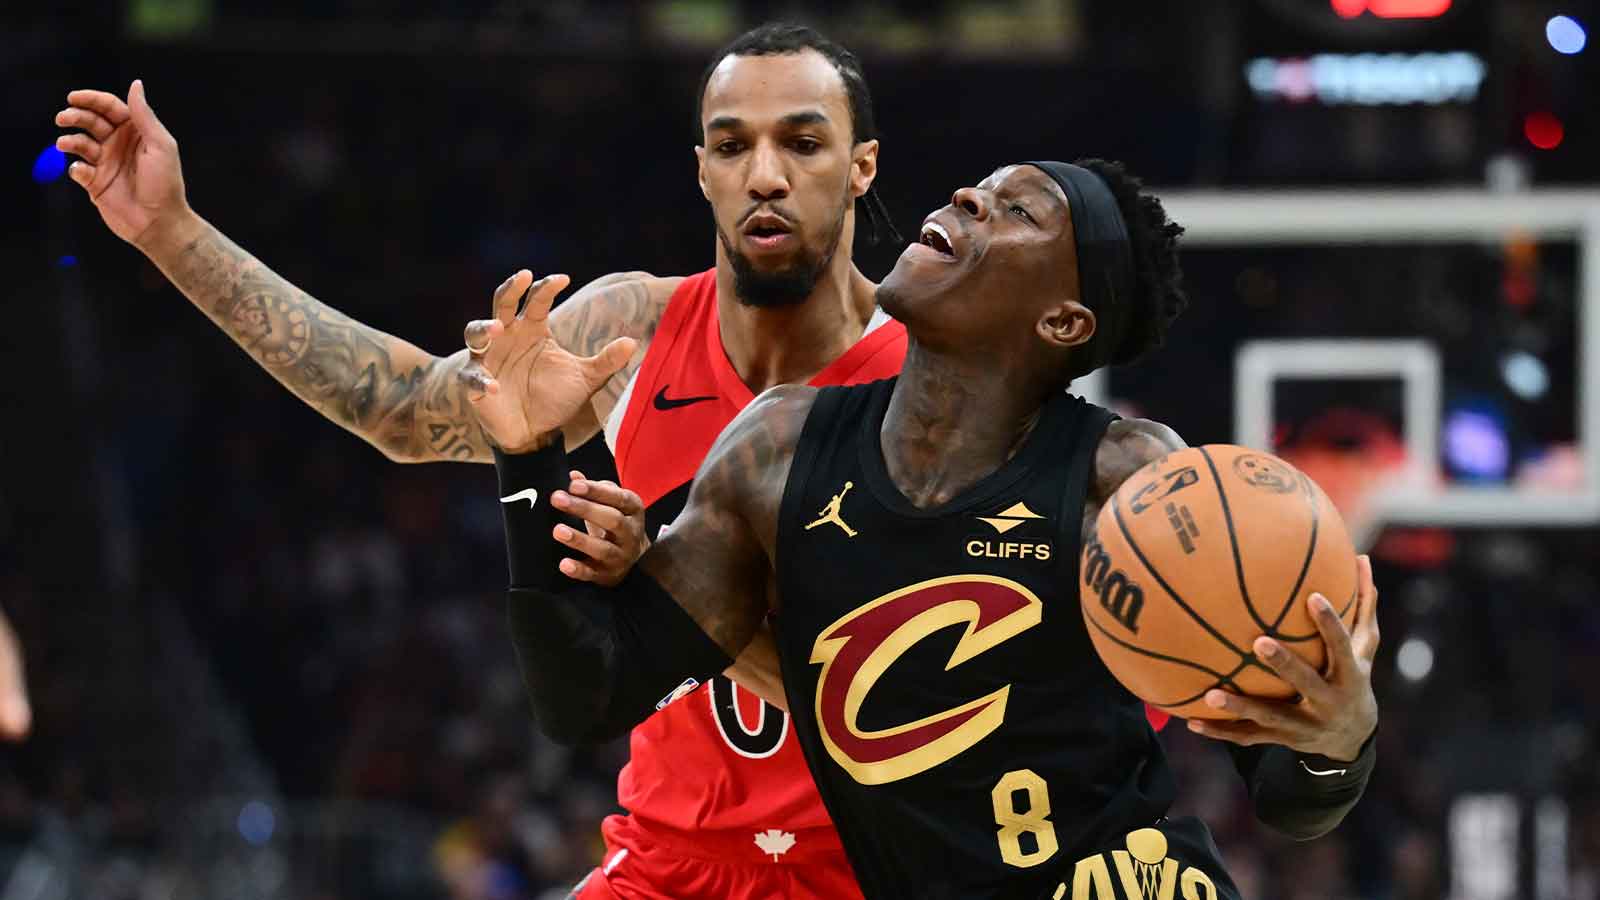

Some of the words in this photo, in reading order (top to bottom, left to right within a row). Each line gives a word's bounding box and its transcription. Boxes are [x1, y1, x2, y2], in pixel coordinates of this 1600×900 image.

[966, 540, 1051, 560] CLIFFS
[808, 574, 1042, 785] C
[991, 768, 1059, 868] 8
